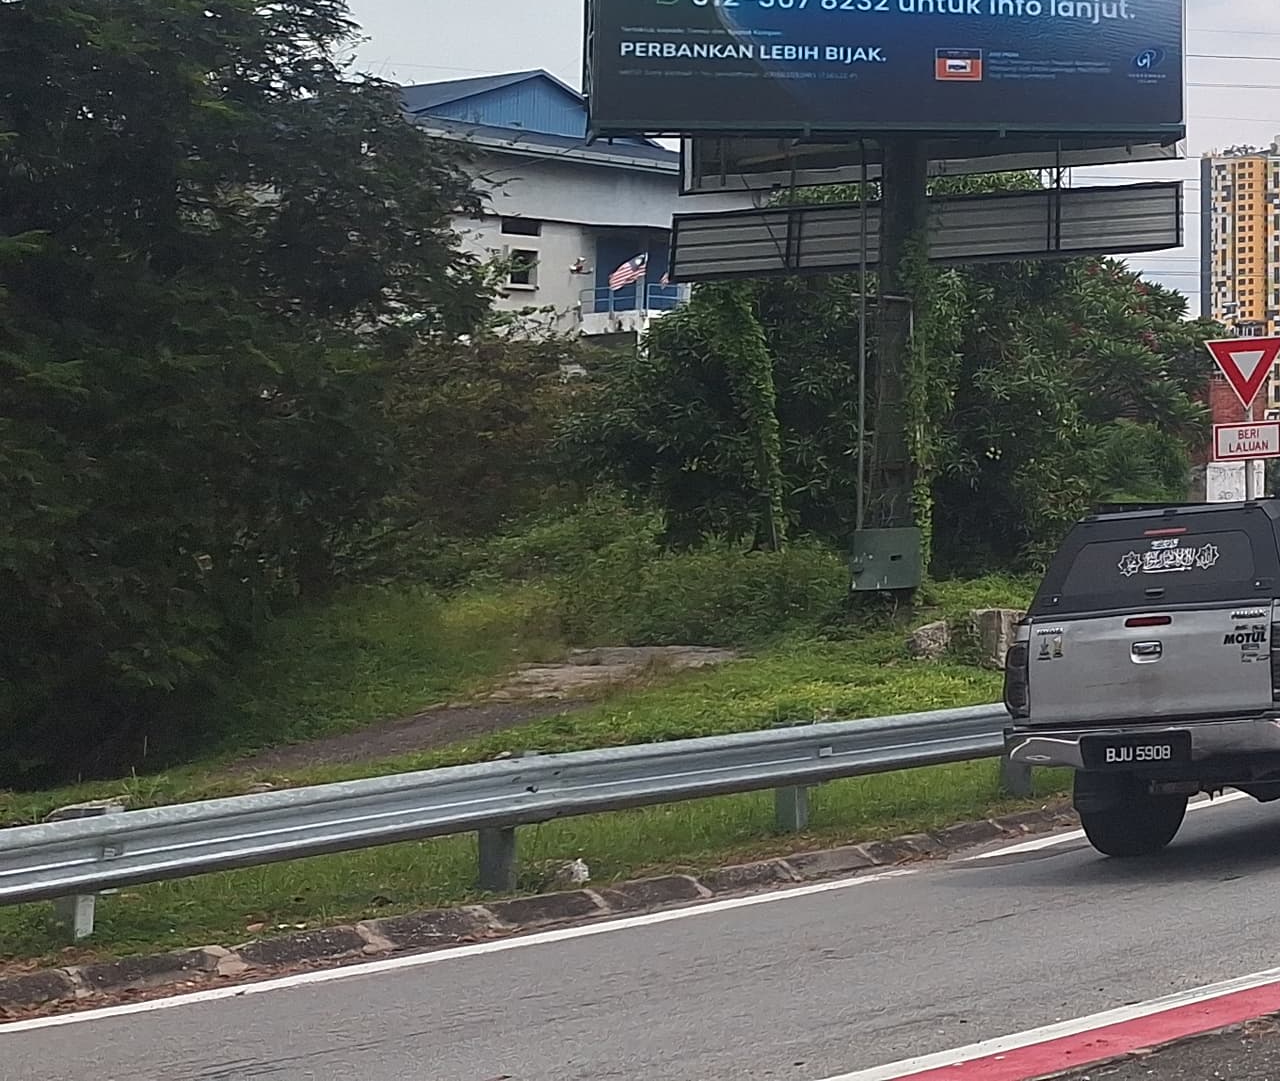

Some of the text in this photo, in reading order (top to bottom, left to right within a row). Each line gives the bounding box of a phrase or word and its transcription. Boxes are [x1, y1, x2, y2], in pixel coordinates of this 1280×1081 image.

[620, 42, 888, 64] PERBANKAN LEBIH BIJAK.
[1238, 428, 1260, 440] BERI
[1229, 440, 1269, 453] LALUAN
[1223, 631, 1267, 645] MOTUL
[1105, 745, 1171, 763] BJU 5908
